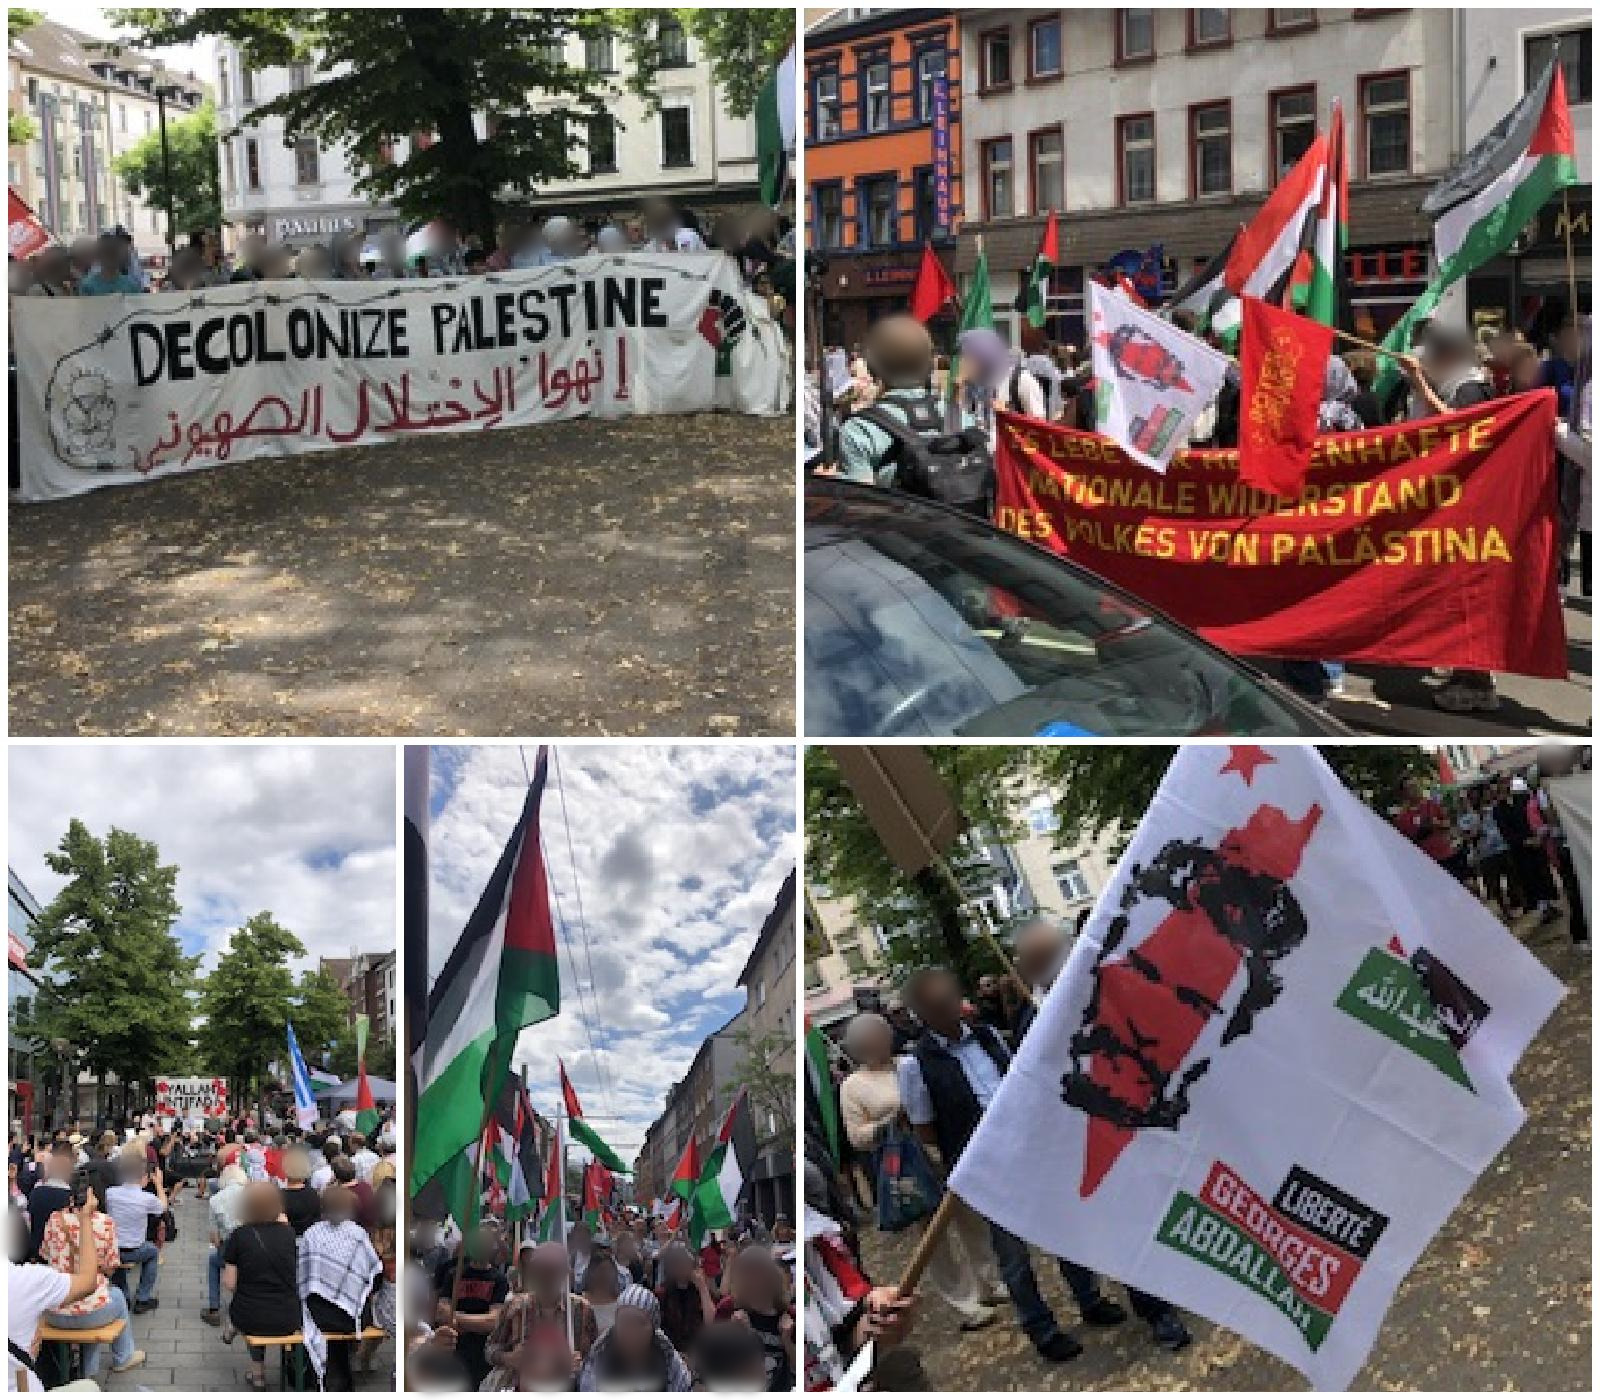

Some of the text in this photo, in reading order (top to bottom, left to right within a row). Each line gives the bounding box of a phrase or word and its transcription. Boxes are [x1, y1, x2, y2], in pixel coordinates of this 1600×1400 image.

[129, 277, 668, 387] DECOLONIZE PALESTINE
[1031, 470, 1463, 517] NATIONALE WIDERSTAND
[1065, 515, 1177, 558] VOLKES
[1188, 529, 1259, 565] VON
[1273, 524, 1513, 566] PALÄSTINA
[1211, 1172, 1341, 1297] GEORGES
[1280, 1180, 1374, 1248] LIBERTÉ
